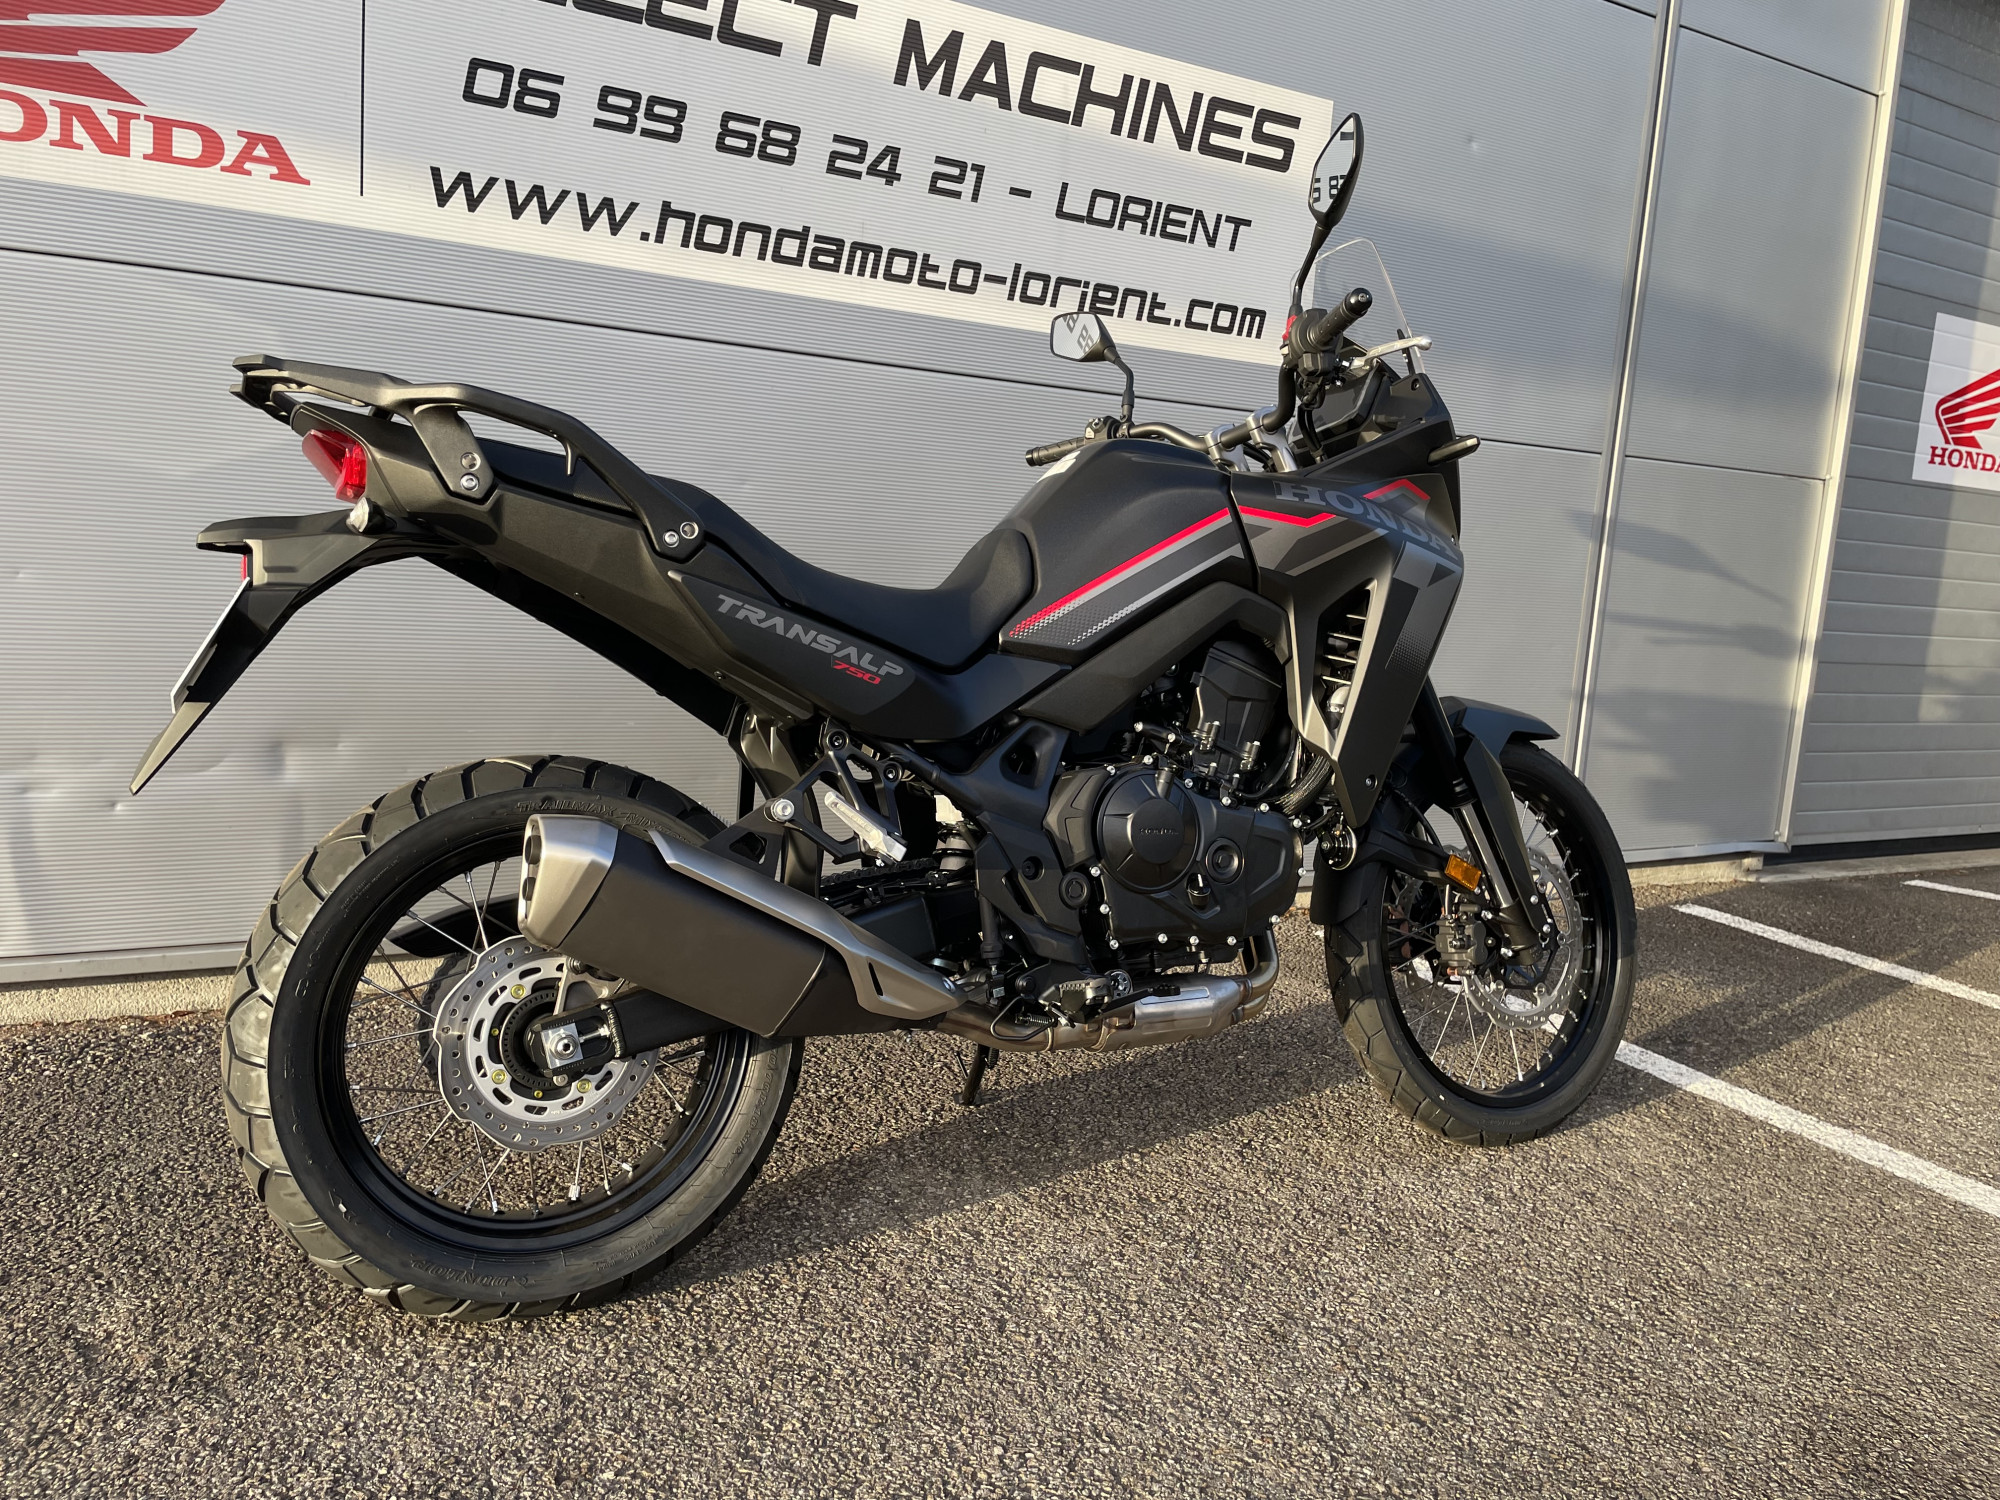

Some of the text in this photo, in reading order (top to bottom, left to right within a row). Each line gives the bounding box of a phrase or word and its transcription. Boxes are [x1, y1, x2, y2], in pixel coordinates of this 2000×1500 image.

[462, 57, 565, 119] 06
[592, 85, 688, 144] 99
[715, 110, 802, 167] 68
[825, 133, 902, 187] 24
[927, 155, 986, 203] 21
[1055, 181, 1253, 252] LORIENT
[893, 18, 1302, 174] MACHINES
[429, 165, 1267, 340] www.hondamoto-lorient.com
[1272, 480, 1459, 561] HONDA
[718, 594, 905, 677] TRANSALP
[832, 659, 881, 686] 750
